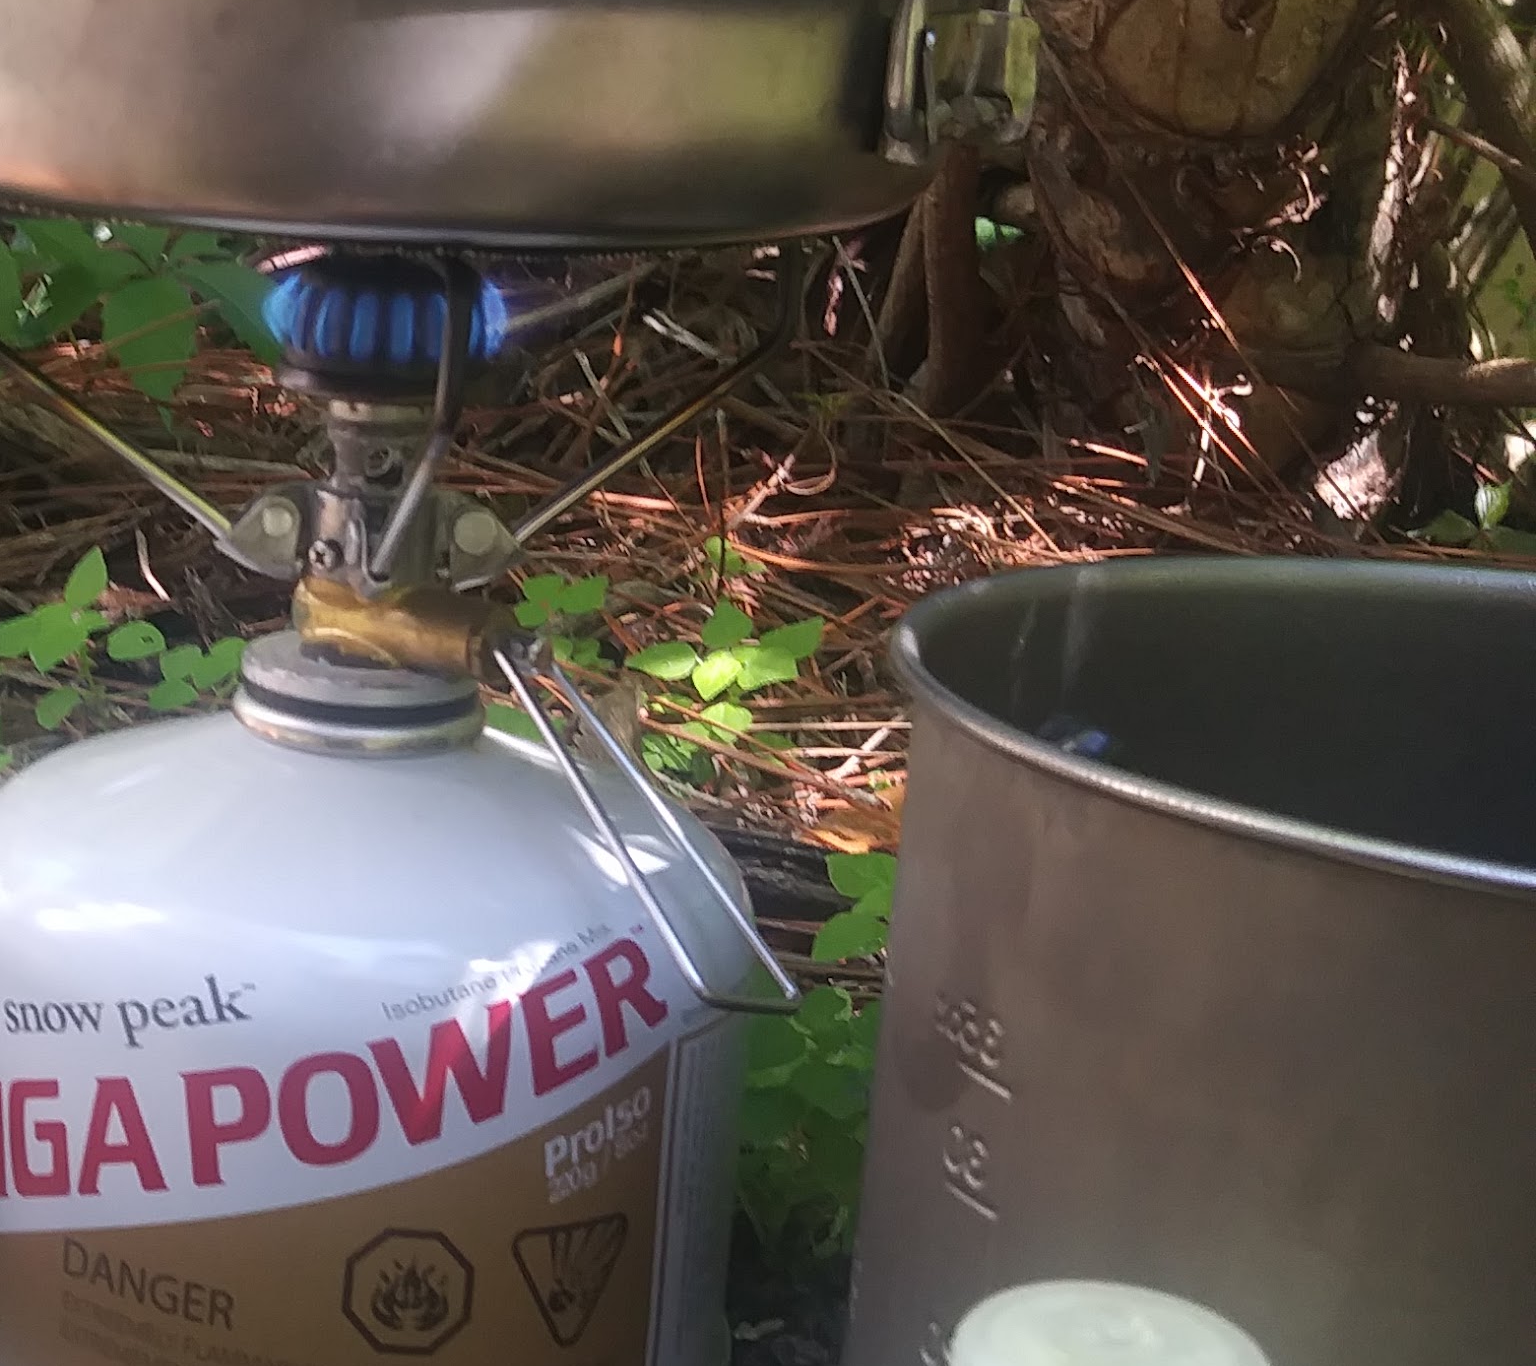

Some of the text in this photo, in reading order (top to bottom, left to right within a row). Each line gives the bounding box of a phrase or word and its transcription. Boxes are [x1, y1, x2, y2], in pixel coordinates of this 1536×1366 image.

[4, 973, 252, 1049] snow peak
[64, 1236, 235, 1332] DANGER
